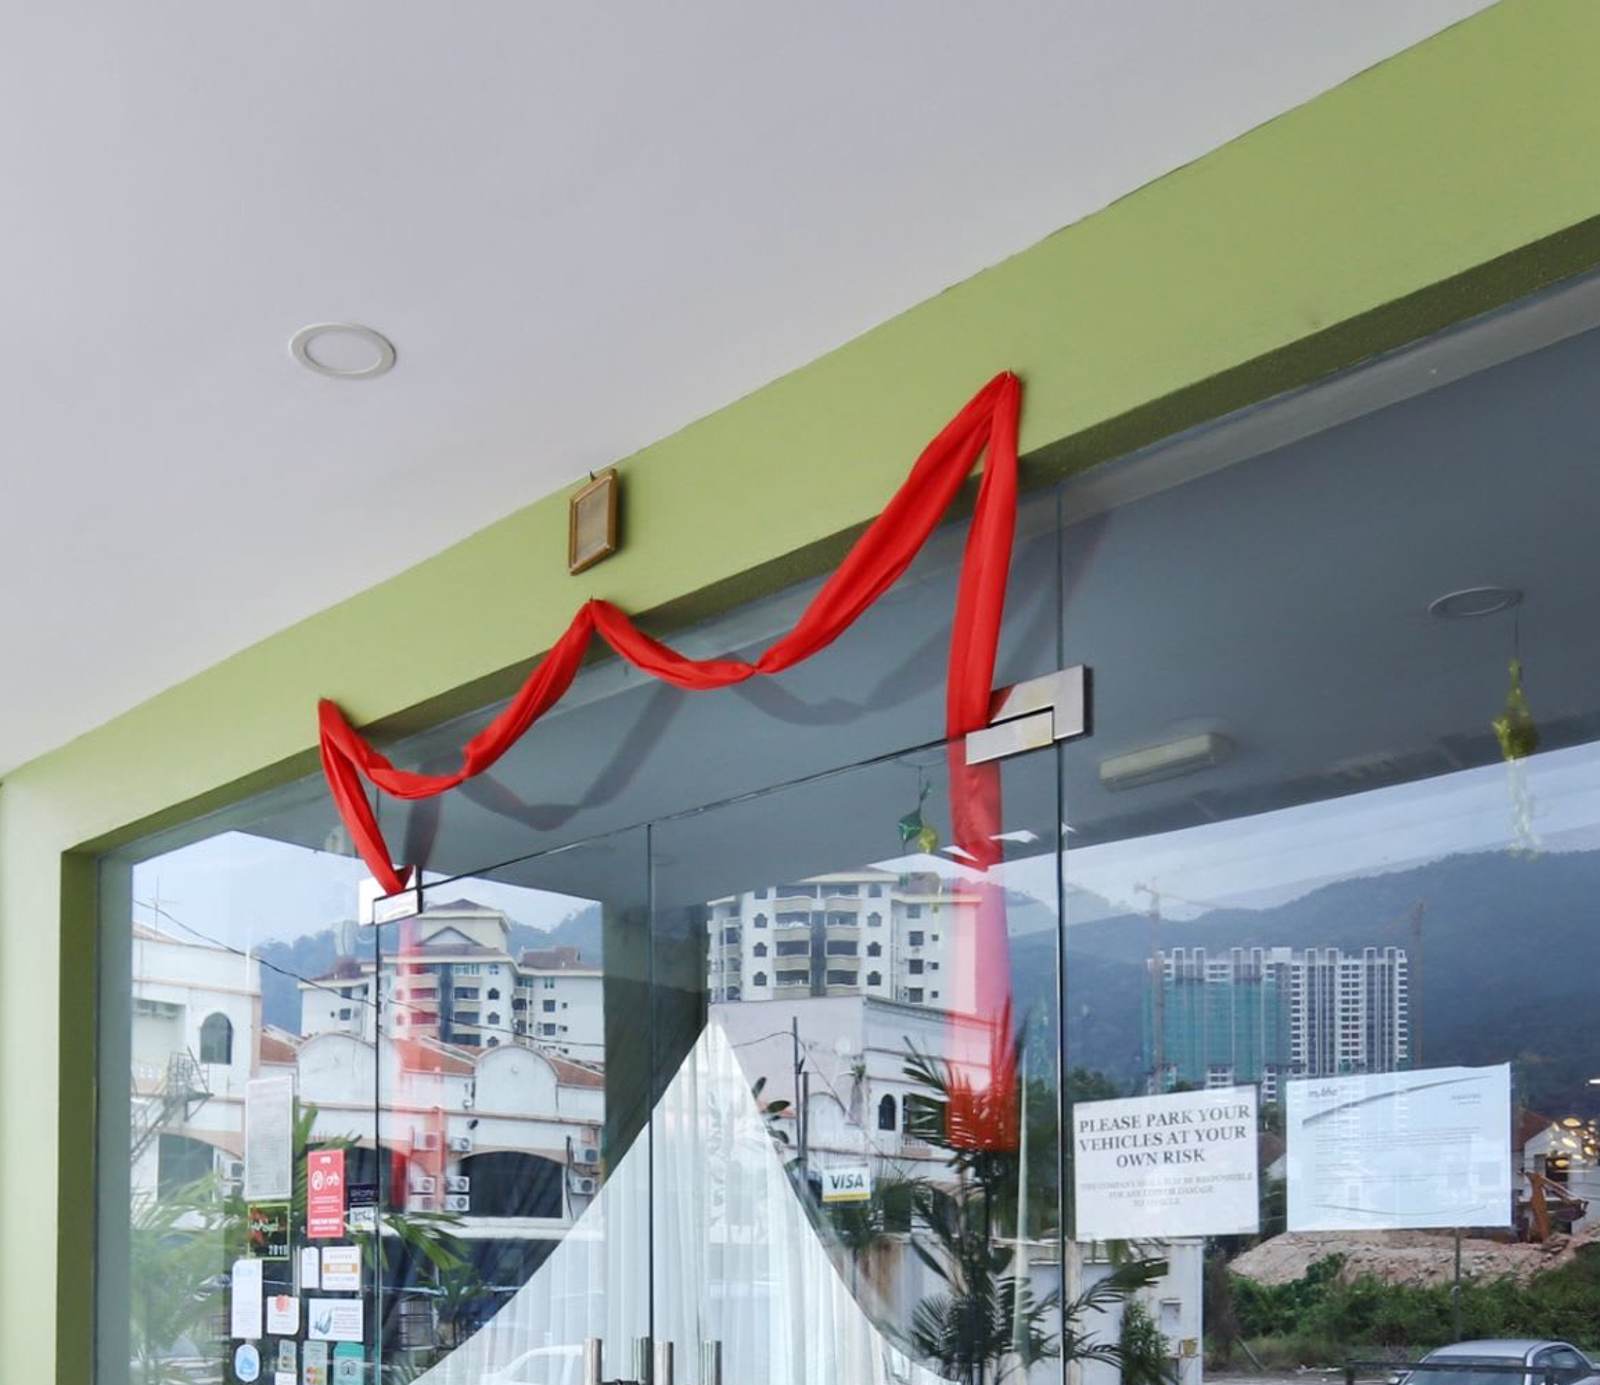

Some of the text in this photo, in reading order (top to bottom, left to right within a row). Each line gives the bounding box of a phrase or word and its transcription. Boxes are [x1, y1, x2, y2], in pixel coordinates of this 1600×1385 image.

[1079, 1104, 1250, 1133] PLEASE PARK YOUR
[1079, 1125, 1248, 1152] VEHICLES AT YOUR
[1116, 1148, 1205, 1168] OWN RISK
[830, 1174, 864, 1189] VISA
